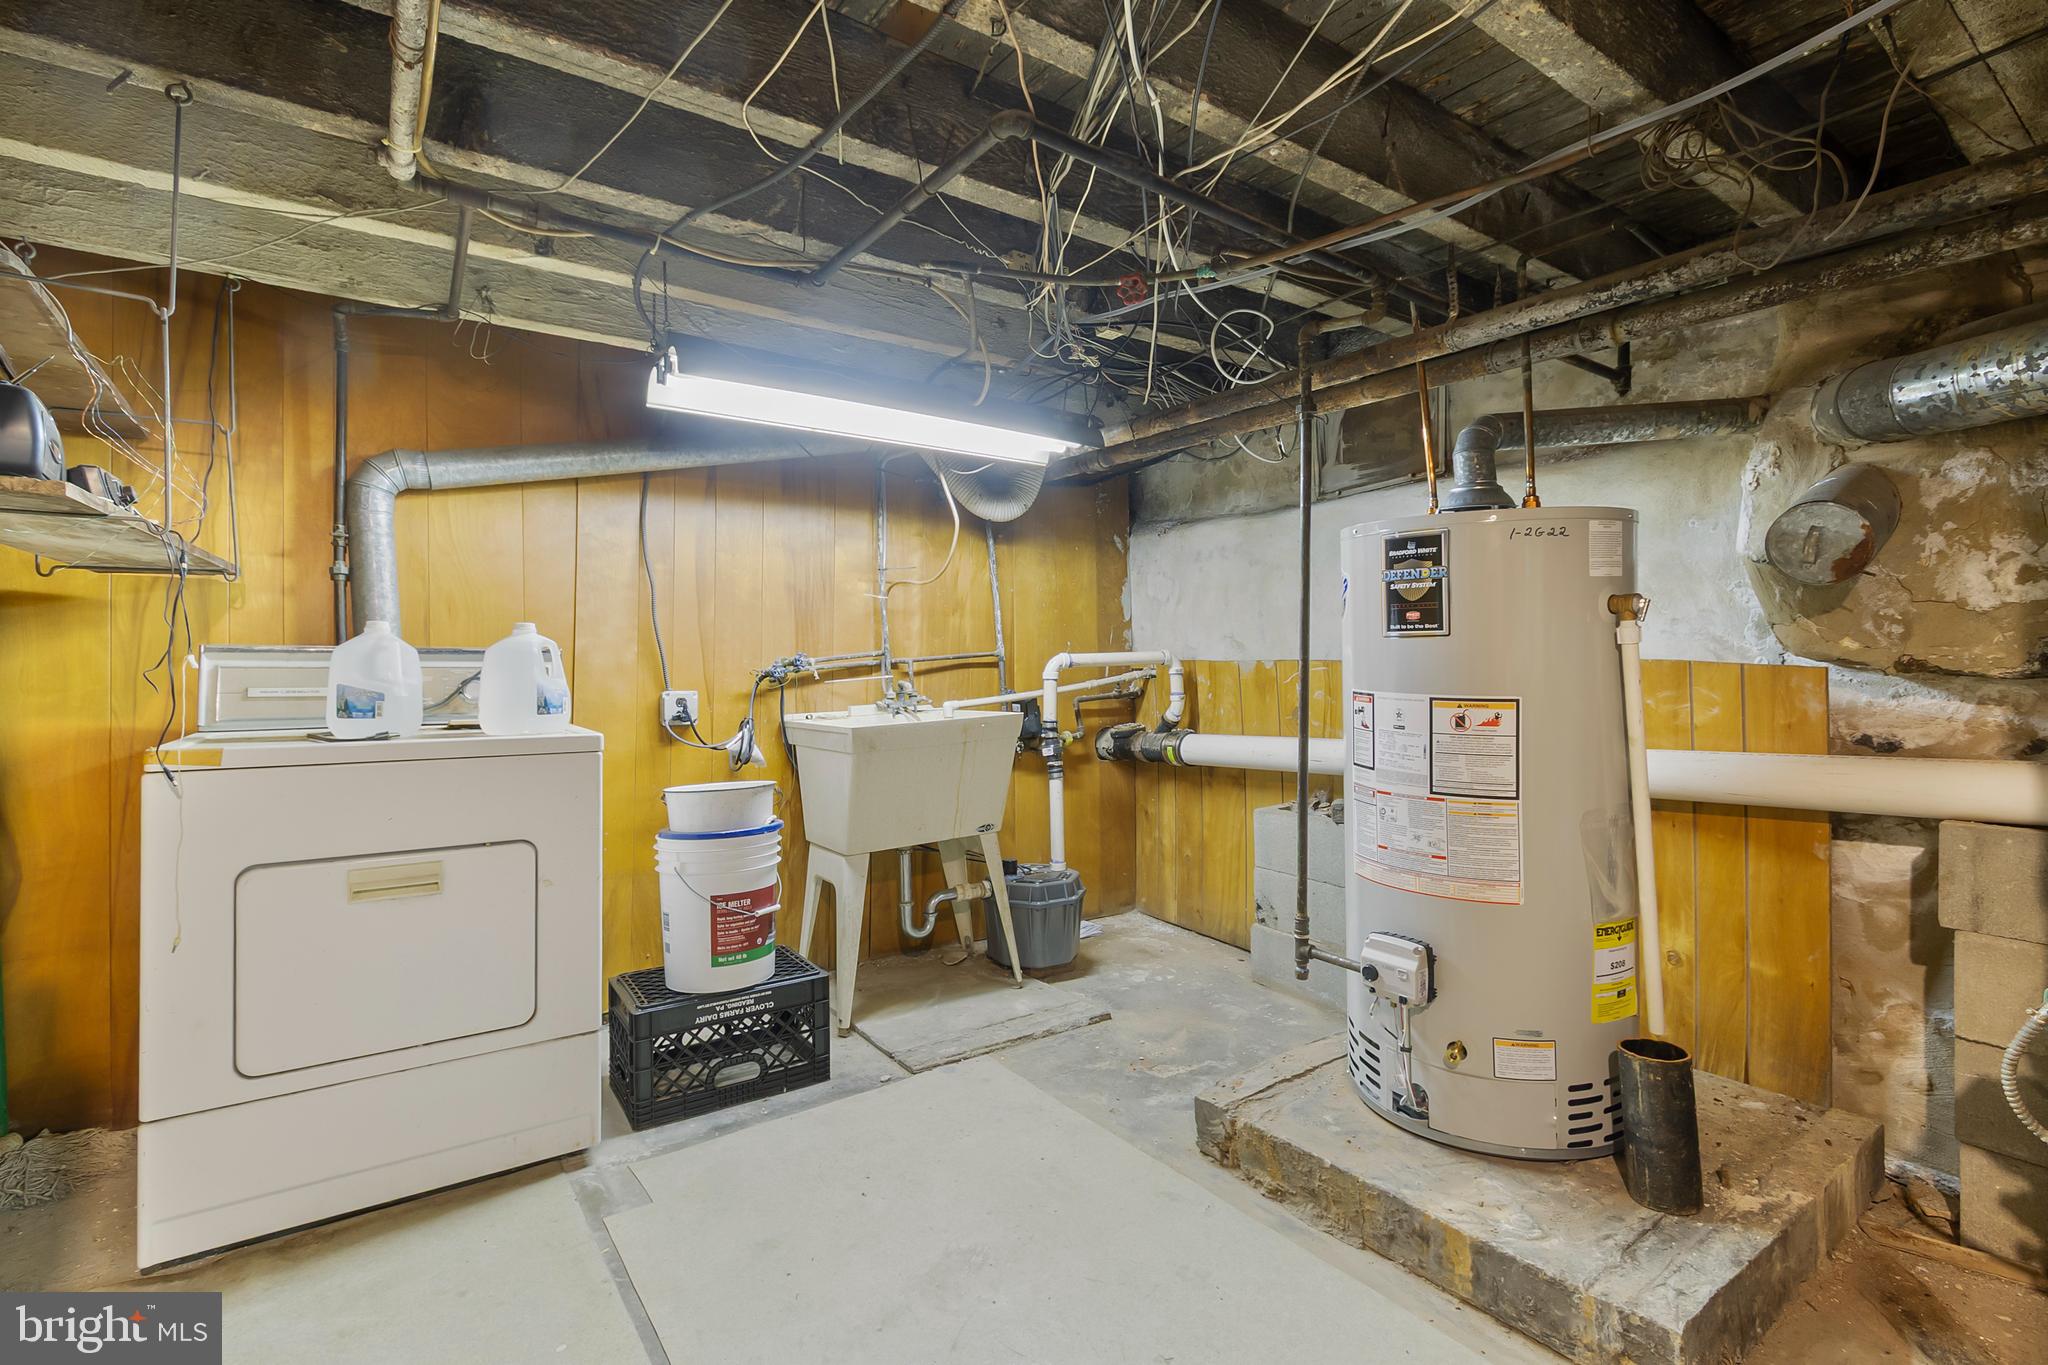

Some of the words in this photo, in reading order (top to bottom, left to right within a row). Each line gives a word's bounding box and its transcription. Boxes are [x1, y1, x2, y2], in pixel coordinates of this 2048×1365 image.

[1383, 567, 1448, 581] DEFENDER
[728, 898, 751, 908] MELTER
[719, 1007, 744, 1019] FARMS
[745, 1001, 775, 1013] CLOVER
[695, 1013, 718, 1024] DAIRY
